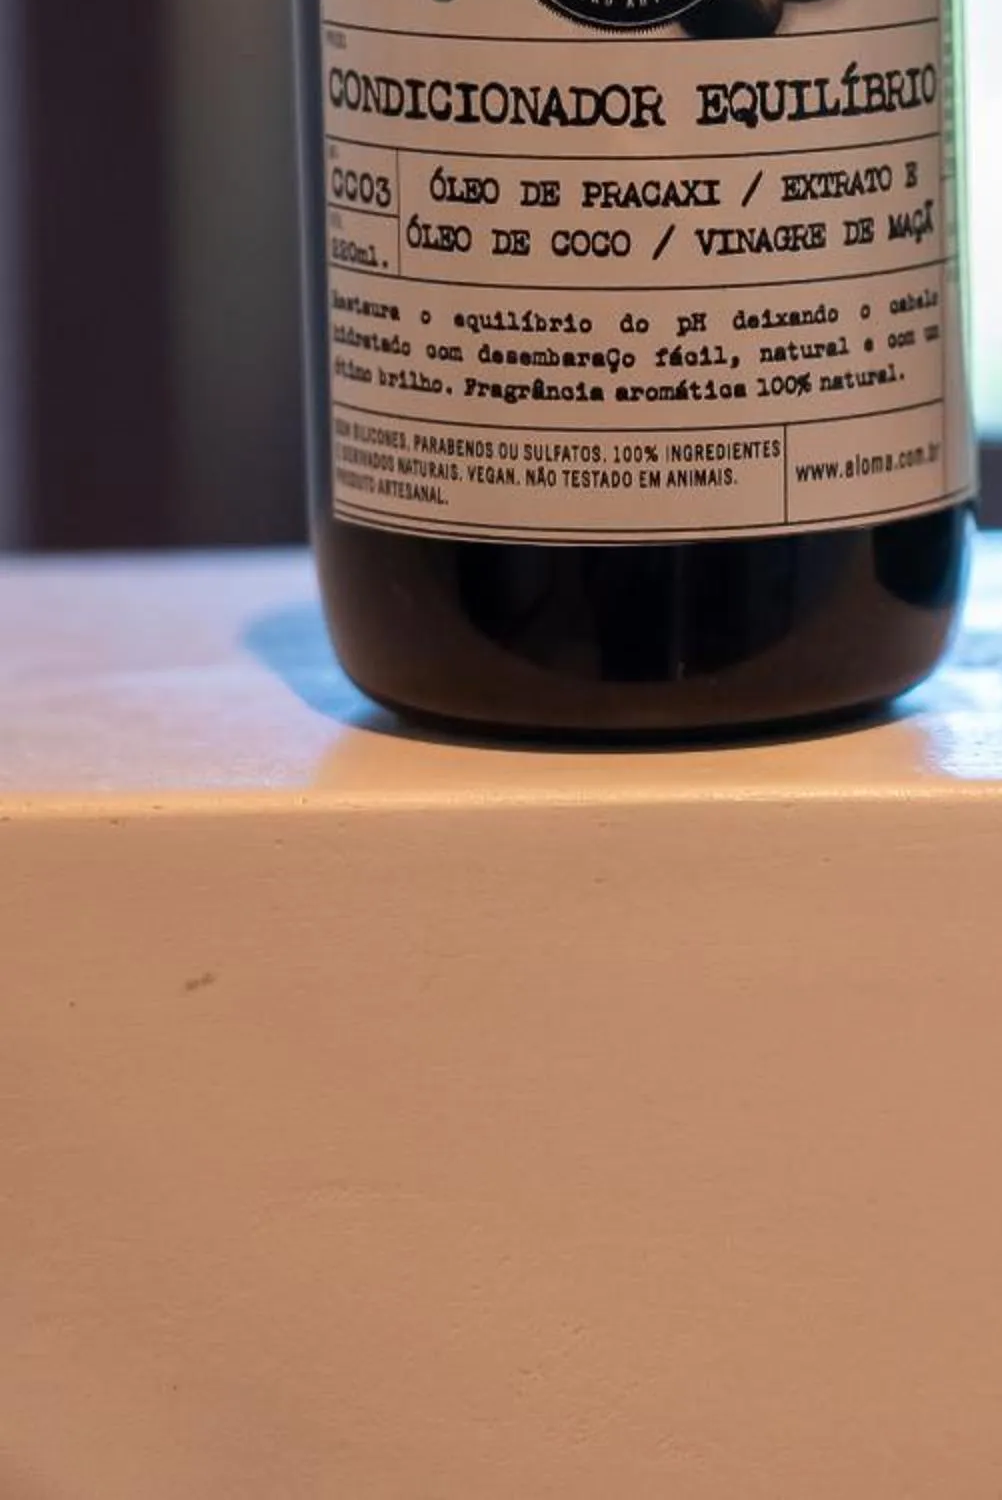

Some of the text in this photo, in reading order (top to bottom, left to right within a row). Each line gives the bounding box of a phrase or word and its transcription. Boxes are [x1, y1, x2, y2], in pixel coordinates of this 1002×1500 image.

[328, 61, 938, 129] CONDICIONADOR EQUILÍBRIO
[430, 166, 500, 204] ÓLEO
[520, 181, 560, 207] DE
[582, 180, 721, 208] PRACAXI
[781, 165, 893, 202] EXTRATO
[905, 161, 918, 188] E
[406, 214, 472, 252] ÓLEO
[492, 229, 531, 256] DE
[551, 230, 631, 257] COCO
[694, 222, 827, 257] VINAGRE
[843, 217, 875, 247] DE
[888, 200, 934, 244] MAÇÃ
[421, 309, 432, 325] o
[454, 310, 593, 336] equilíbrio
[620, 314, 650, 334] do
[676, 313, 707, 337] pH
[733, 304, 839, 331] deixando
[860, 303, 871, 319] o
[426, 344, 464, 362] com
[655, 347, 740, 369] fácil,
[759, 337, 850, 364] natural
[463, 377, 604, 404] Fragrância
[615, 380, 747, 402] aromática
[757, 372, 812, 397] 100%
[819, 363, 905, 392] natural.
[413, 434, 493, 461] PARABENOS
[499, 443, 519, 461] OU
[614, 445, 658, 463] 100%
[665, 439, 781, 463] INGREDIENTES
[525, 467, 557, 488] NÃO
[562, 469, 633, 489] TESTADO
[639, 470, 661, 489] EM
[666, 467, 738, 489] ANIMAIS.
